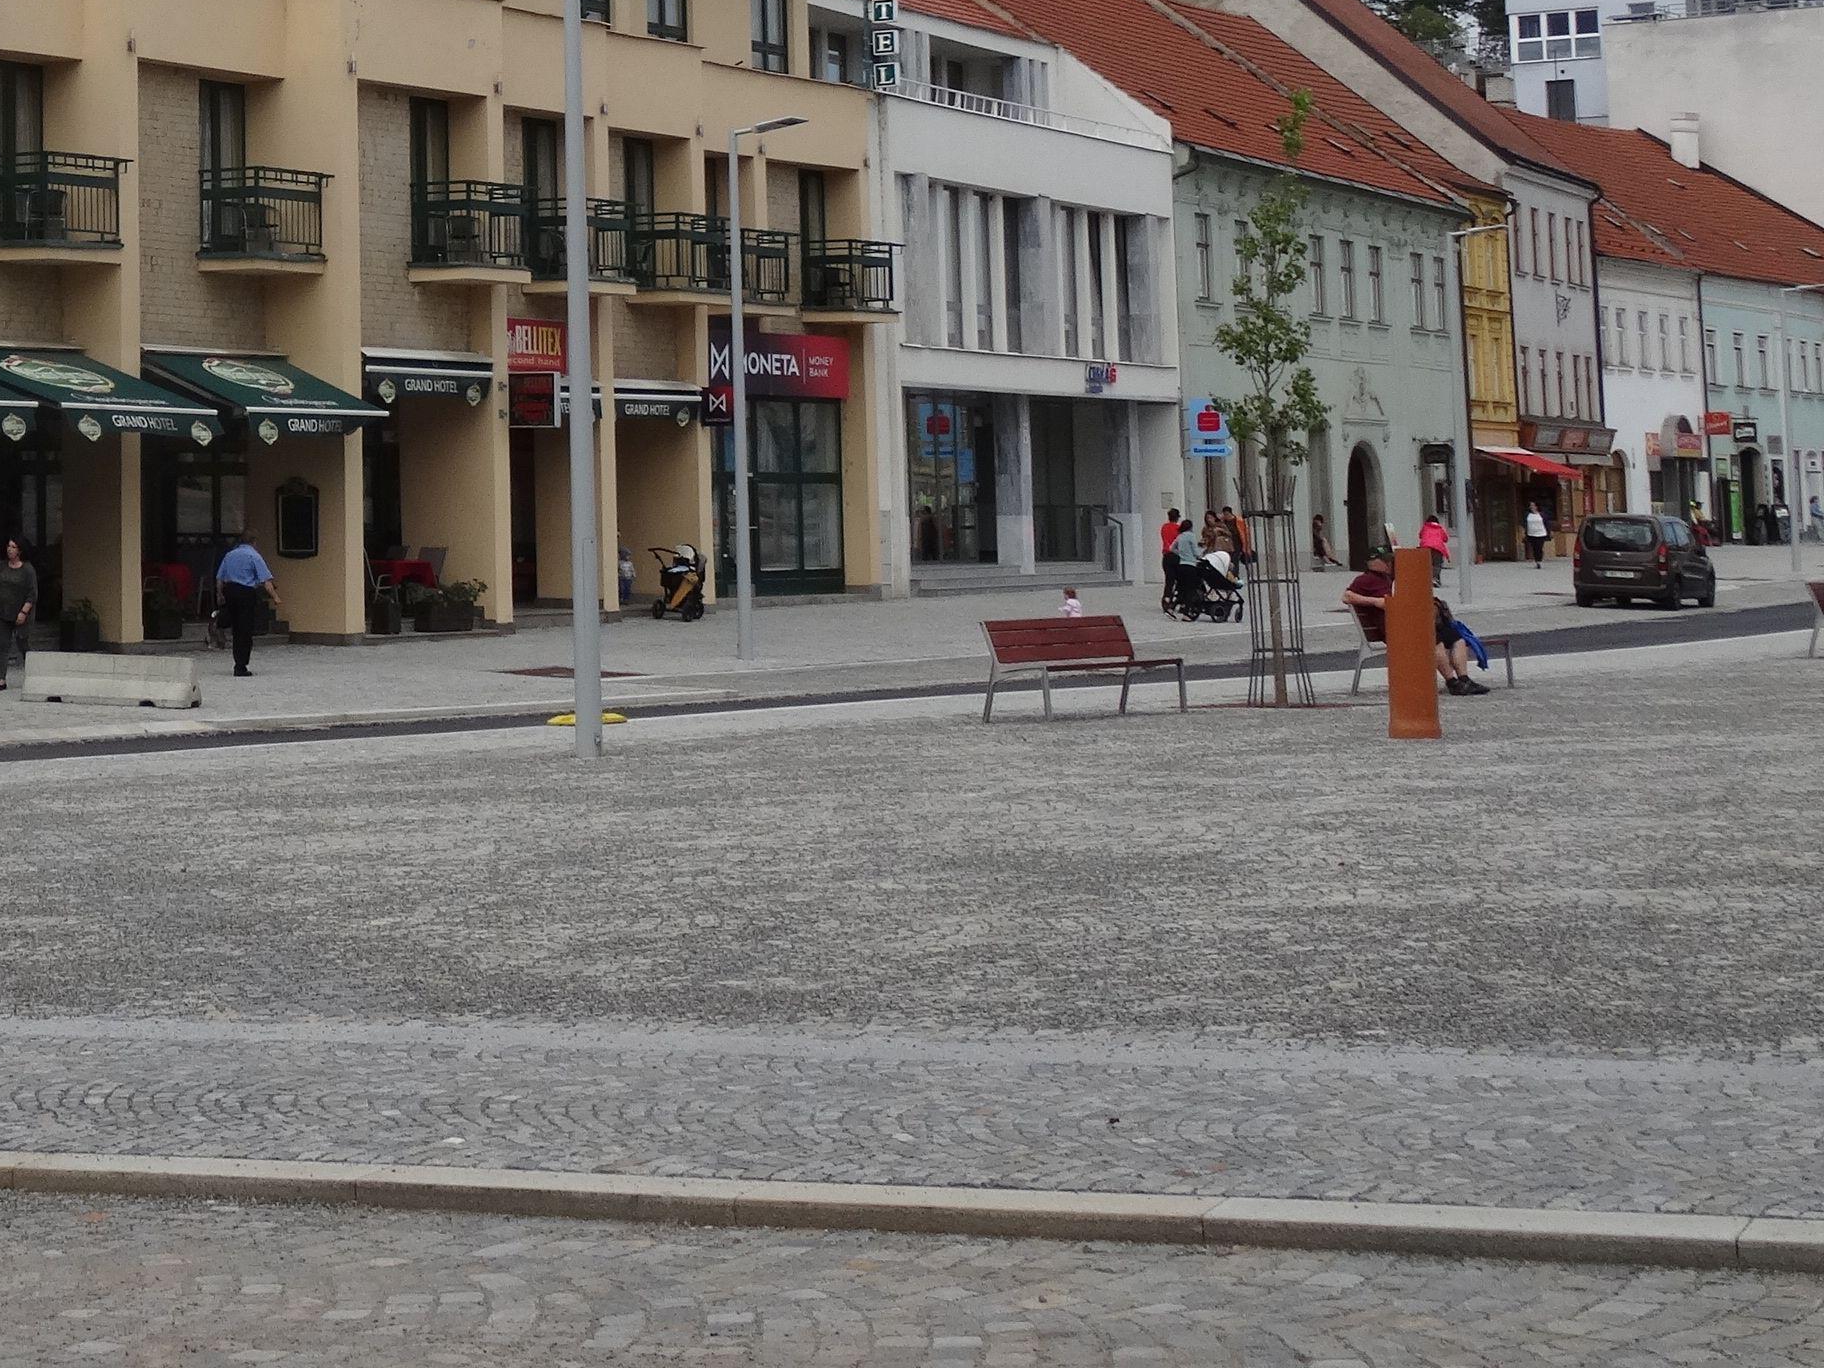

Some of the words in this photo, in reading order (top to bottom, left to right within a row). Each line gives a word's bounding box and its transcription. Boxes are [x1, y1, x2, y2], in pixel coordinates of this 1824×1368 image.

[515, 325, 562, 356] BELLITEX
[537, 358, 561, 367] hand
[808, 356, 834, 366] MONEY
[808, 367, 830, 378] BANK
[404, 378, 433, 392] GRAND
[434, 380, 458, 393] HOTEL
[624, 403, 649, 416] GRAND
[649, 404, 670, 416] HOTEL
[111, 414, 148, 429] GRAND
[148, 417, 178, 432] HOTEL
[287, 418, 318, 433] GRAND
